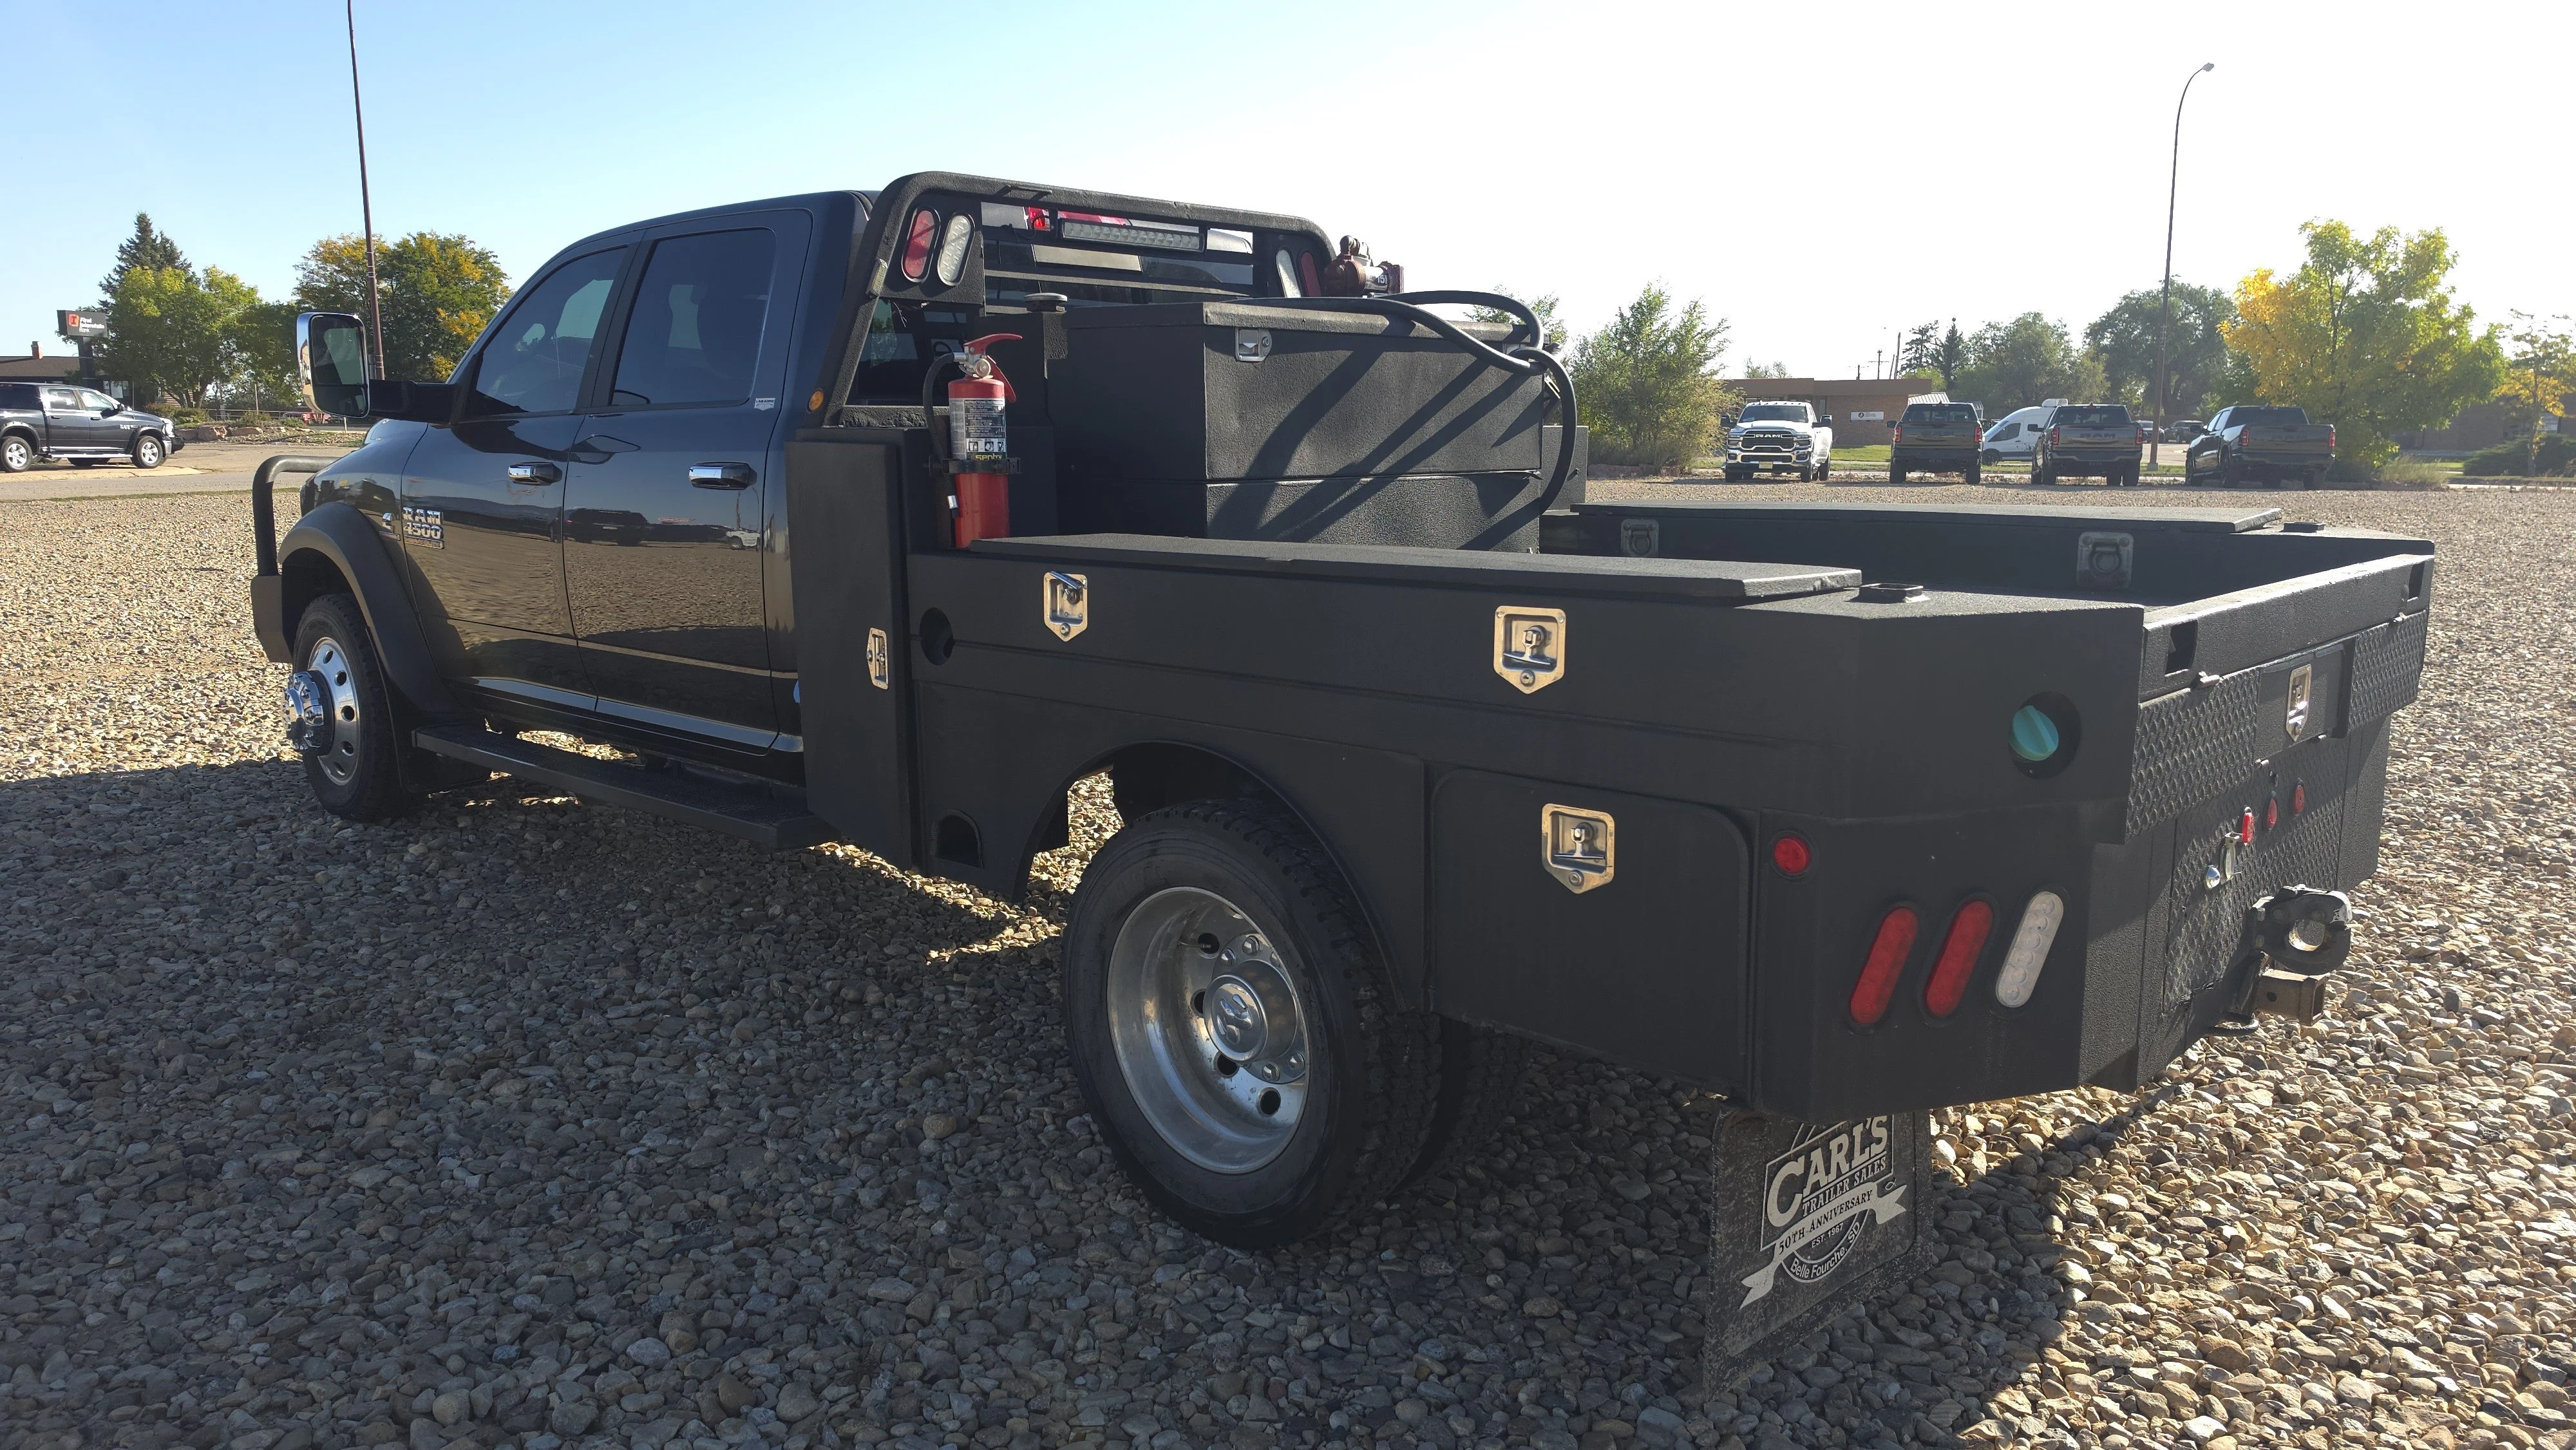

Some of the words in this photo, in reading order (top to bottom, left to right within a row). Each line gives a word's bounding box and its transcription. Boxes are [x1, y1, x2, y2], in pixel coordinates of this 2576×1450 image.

[402, 507, 442, 525] RAM
[403, 522, 444, 540] 4500
[1767, 1115, 1888, 1227] CARL'S
[1803, 1178, 1850, 1217] TRAILER
[1853, 1156, 1886, 1186] SALES
[1778, 1227, 1805, 1255] 50TH
[1808, 1190, 1873, 1233] ANNIVERSARY
[1790, 1257, 1810, 1278] Belle
[1848, 1221, 1861, 1244] SD
[1811, 1234, 1826, 1248] EST.
[1827, 1223, 1844, 1238] 1967
